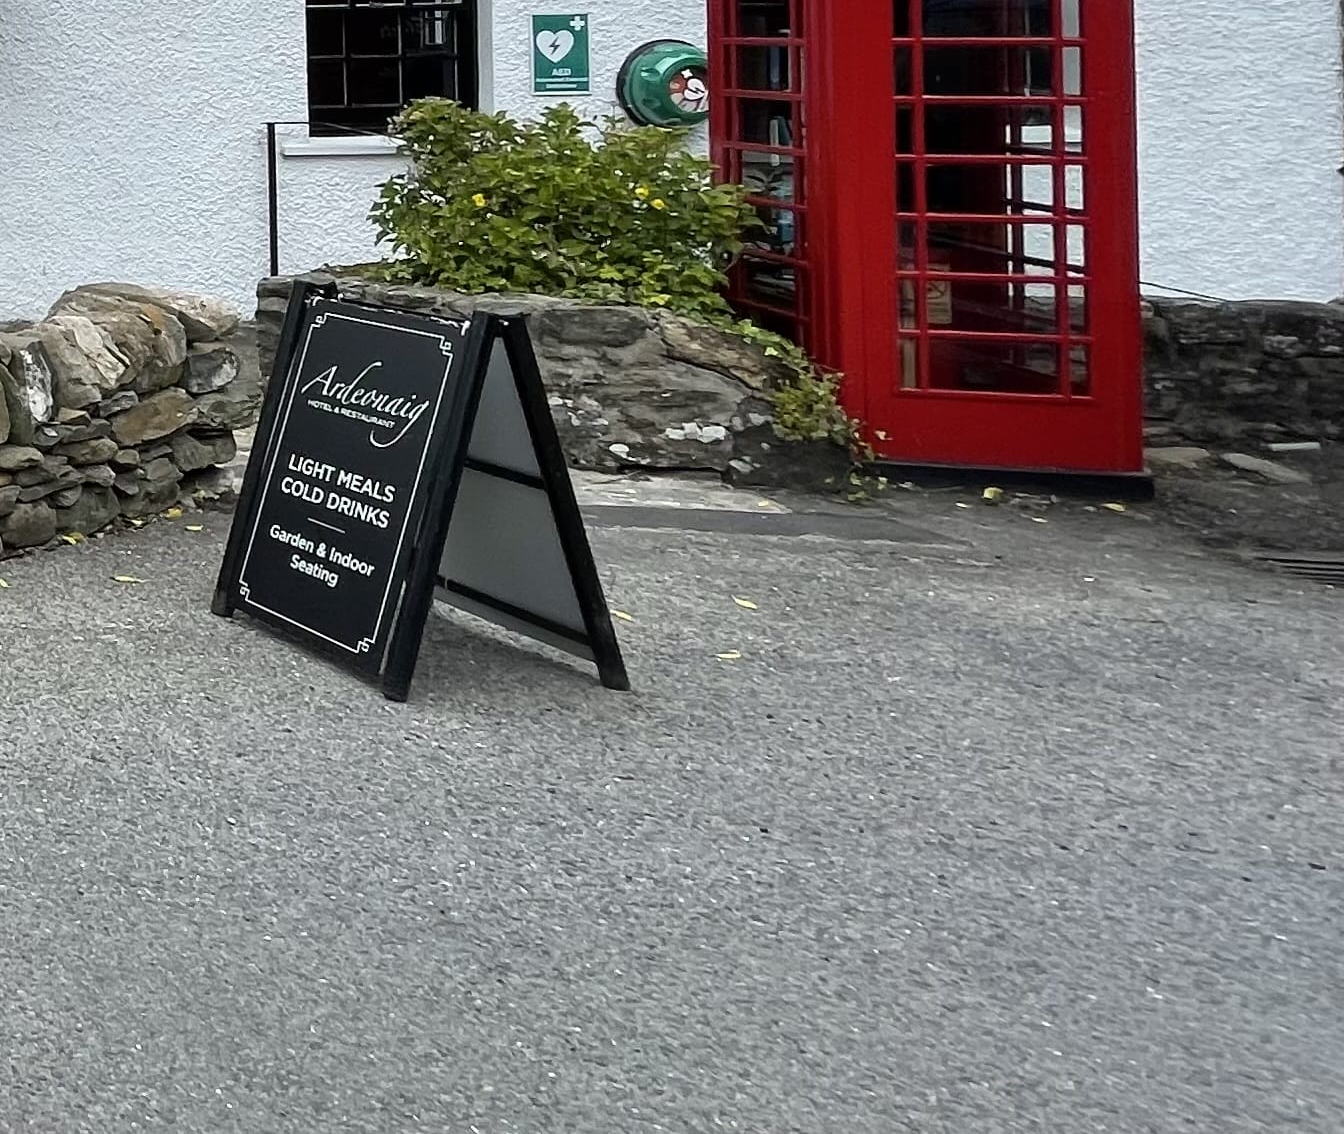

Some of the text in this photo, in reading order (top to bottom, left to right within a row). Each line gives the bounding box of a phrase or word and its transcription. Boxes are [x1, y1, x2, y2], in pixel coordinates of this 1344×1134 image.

[301, 361, 430, 448] Ardeonaig
[308, 398, 333, 413] HOTEL
[340, 407, 396, 429] RESTAURANT
[280, 476, 391, 529] COLD DRINKS
[288, 453, 396, 504] LIGHT MEALS
[269, 524, 376, 577] Garden & Indoor
[289, 554, 340, 588] Seating
